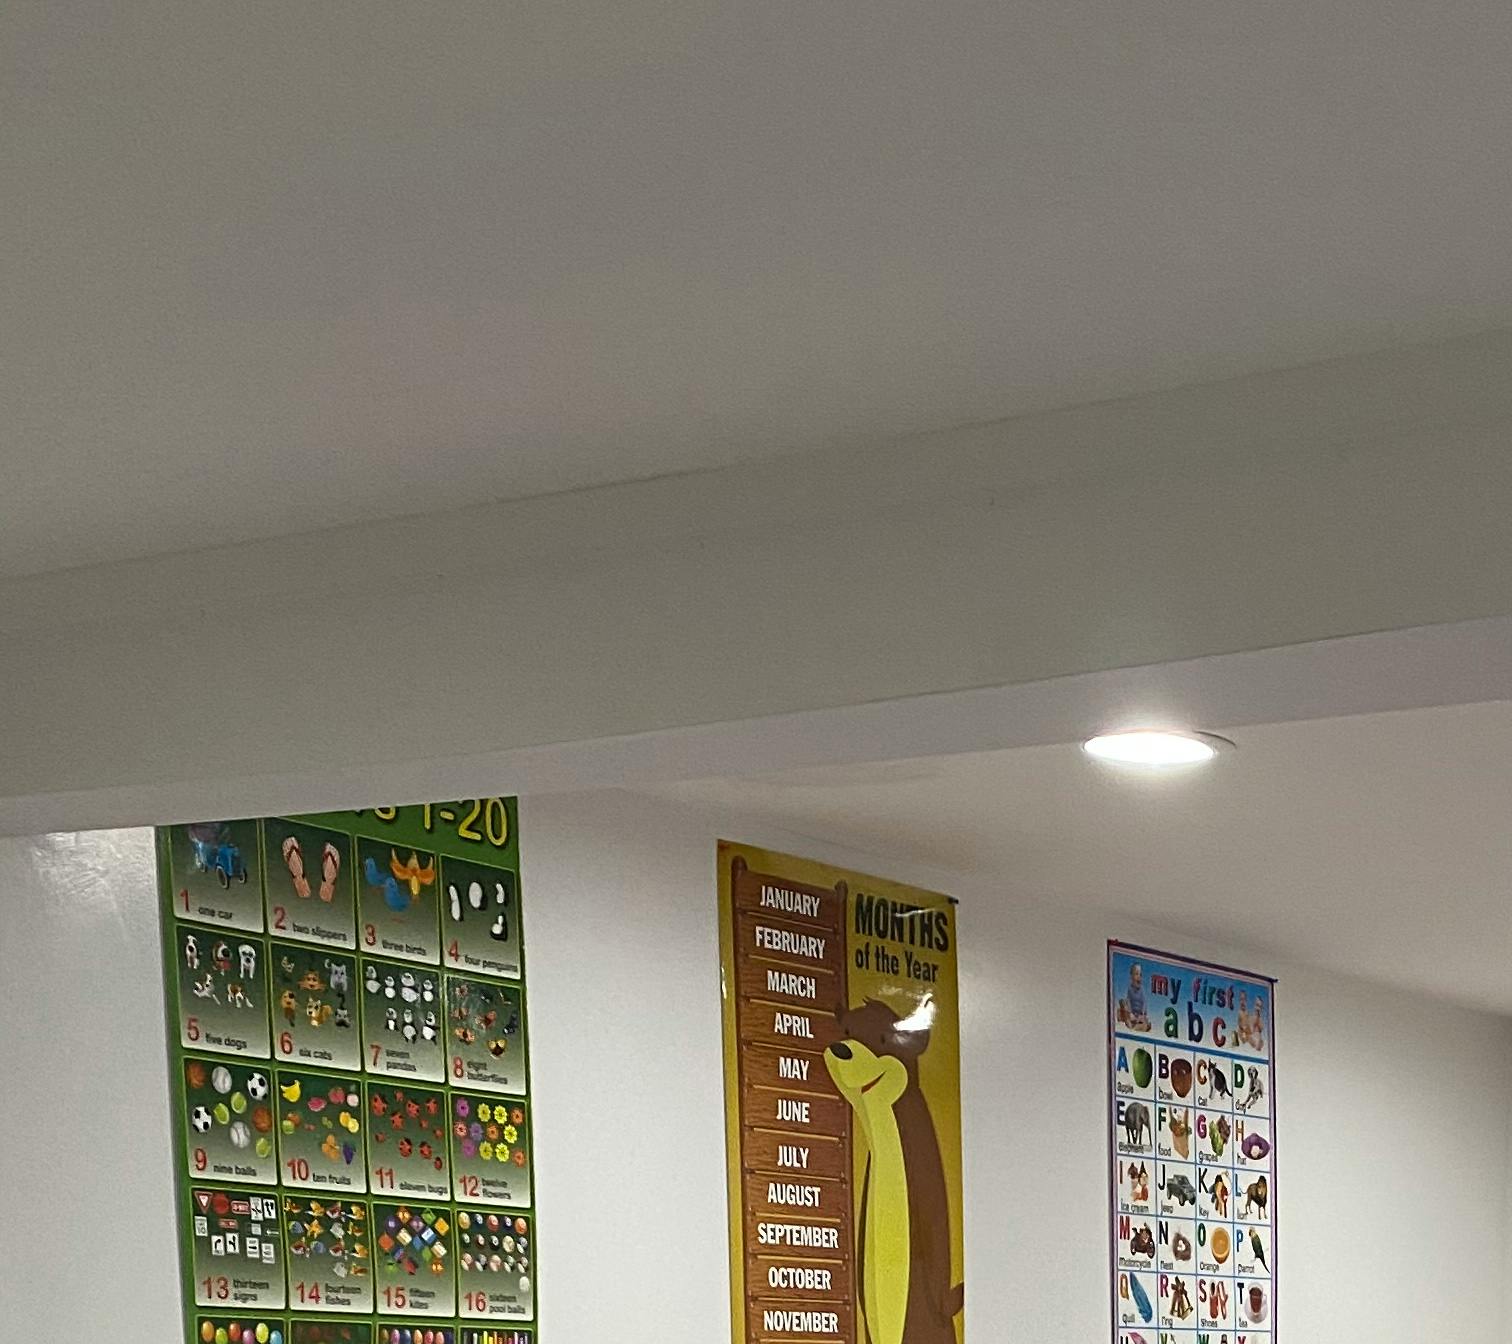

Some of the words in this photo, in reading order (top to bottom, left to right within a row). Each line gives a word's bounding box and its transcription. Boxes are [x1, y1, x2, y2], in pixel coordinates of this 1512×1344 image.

[179, 888, 190, 913] 1
[198, 905, 215, 917] one
[217, 909, 233, 920] car
[760, 885, 820, 917] JANUARY
[273, 905, 286, 931] 2
[292, 922, 310, 934] two
[311, 924, 347, 942] slippers
[855, 893, 949, 952] MONTHS
[365, 923, 376, 946] 3
[382, 939, 404, 953] three
[405, 943, 427, 956] birds
[755, 926, 825, 959] FEBRUARY
[448, 938, 460, 962] 4
[464, 954, 481, 966] four
[855, 942, 869, 969] of
[874, 945, 899, 976] the
[904, 951, 939, 983] Year
[767, 970, 816, 999] MARCH
[1151, 974, 1181, 1004] my
[1192, 976, 1235, 1010] first
[186, 1017, 200, 1042] 5
[205, 1033, 223, 1046] five
[224, 1038, 248, 1050] dogs
[774, 1012, 814, 1038] APRIL
[1164, 1006, 1178, 1038] a
[1187, 1000, 1203, 1042] b
[1212, 1016, 1226, 1047] c
[280, 1031, 293, 1055] 6
[299, 1048, 311, 1059] six
[313, 1049, 332, 1061] cats
[370, 1043, 382, 1067] 7
[386, 1050, 410, 1059] seven
[386, 1061, 416, 1072] pandas
[453, 1056, 464, 1079] 8
[779, 1056, 809, 1080] MAY
[1117, 1047, 1129, 1073] A
[1159, 1053, 1169, 1079] B
[1197, 1060, 1207, 1085] C
[1234, 1064, 1244, 1088] D
[776, 1099, 810, 1123] JUNE
[1117, 1101, 1126, 1125] E
[1159, 1107, 1166, 1131] F
[1197, 1115, 1207, 1139] G
[1236, 1120, 1244, 1141] H
[194, 1147, 207, 1171] 9
[213, 1164, 233, 1175] nine
[235, 1165, 257, 1177] balls
[777, 1145, 809, 1168] JULY
[287, 1158, 309, 1182] 10
[313, 1172, 327, 1183] ten
[328, 1173, 351, 1185] fruits
[375, 1166, 394, 1190] 11
[400, 1181, 426, 1192] eleven
[428, 1183, 448, 1196] bugs
[481, 1177, 508, 1189] twelve
[1158, 1164, 1165, 1190] J
[1199, 1168, 1208, 1193] K
[459, 1174, 480, 1198] 12
[482, 1188, 512, 1200] flowers
[768, 1182, 821, 1207] AUGUST
[1235, 1174, 1241, 1197] L
[757, 1223, 838, 1248] SEPTEMBER
[1120, 1216, 1130, 1240] M
[1159, 1221, 1168, 1245] N
[1198, 1223, 1206, 1246] O
[1237, 1229, 1243, 1252] P
[203, 1276, 229, 1300] 13
[233, 1278, 270, 1290] thirteen
[325, 1283, 362, 1294] fourteen
[768, 1266, 831, 1290] OCTOBER
[1120, 1274, 1129, 1300] Q
[1160, 1275, 1169, 1298] R
[233, 1292, 258, 1304] signs
[295, 1281, 321, 1304] 14
[325, 1295, 351, 1306] fishes
[383, 1286, 406, 1309] 15
[464, 1291, 486, 1313] 16
[1199, 1279, 1207, 1302] S
[1237, 1282, 1244, 1304] T
[409, 1300, 429, 1310] kites
[489, 1304, 506, 1315] pool
[507, 1304, 526, 1315] balls
[763, 1310, 838, 1333] NOVEMBER
